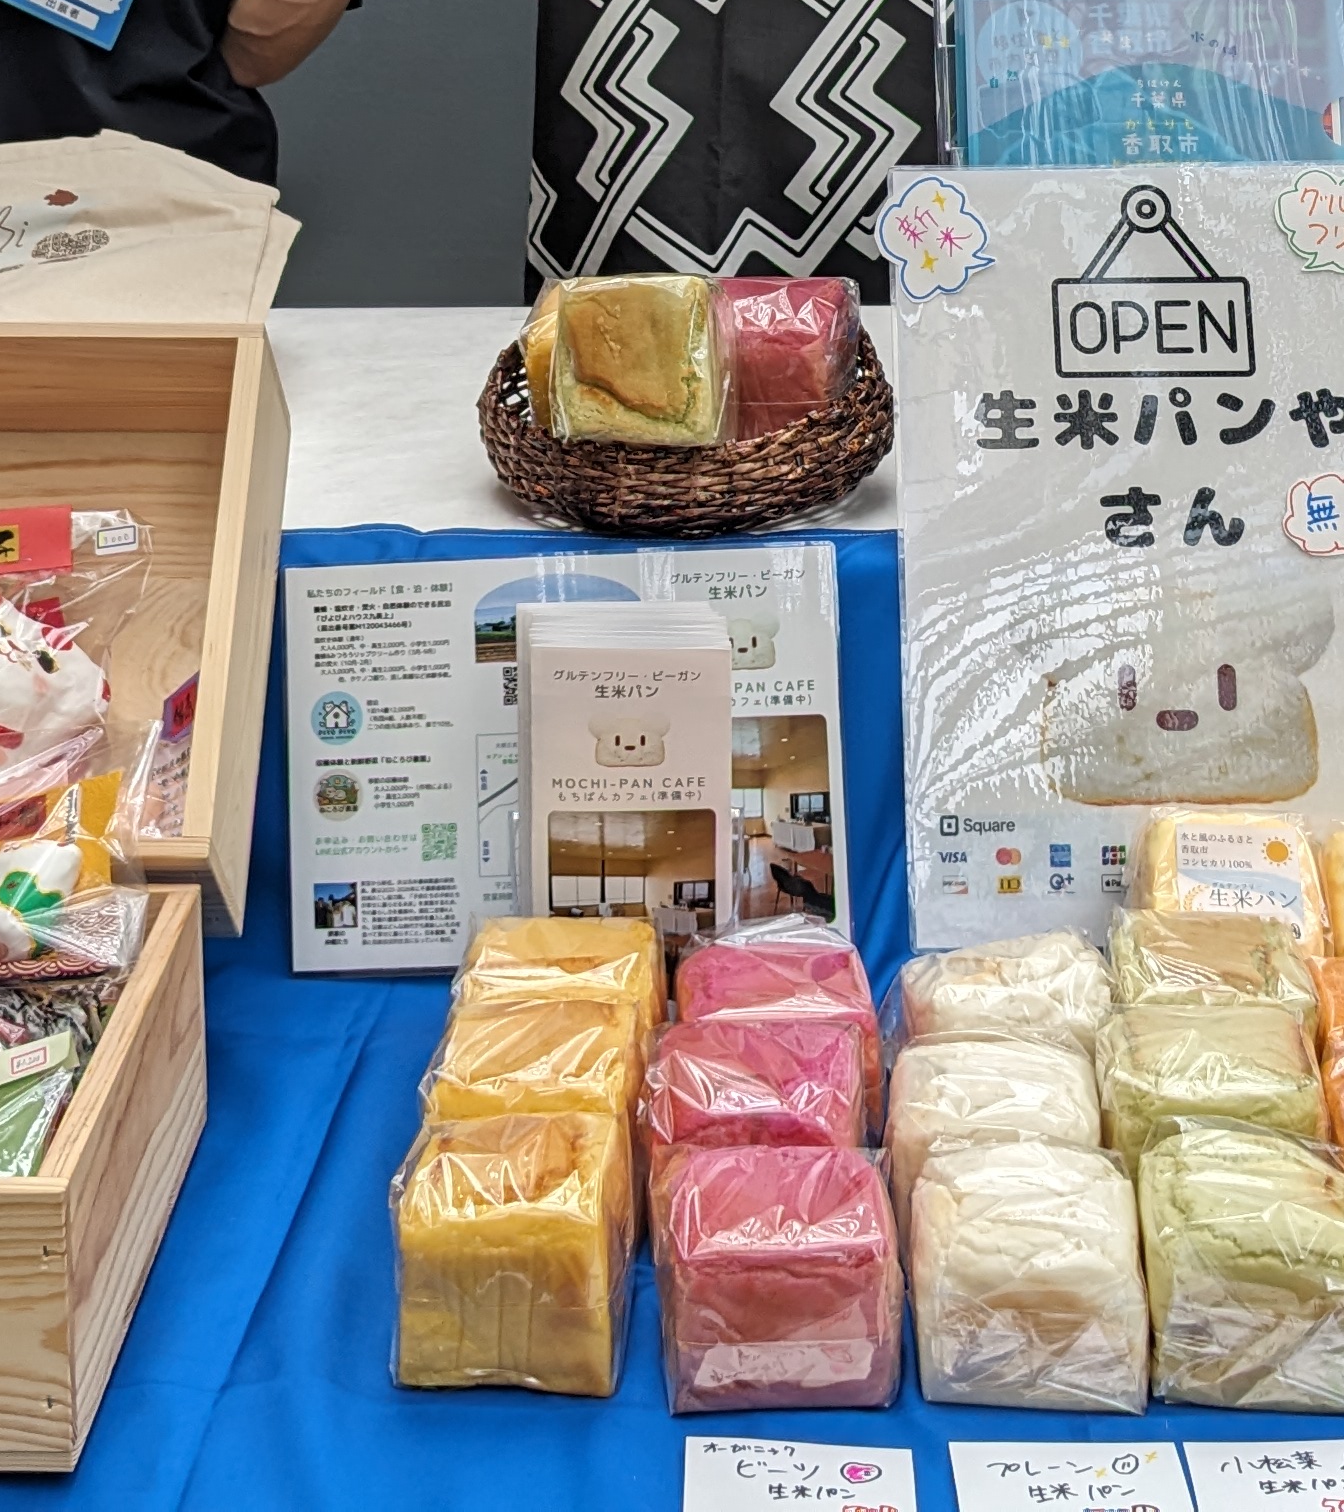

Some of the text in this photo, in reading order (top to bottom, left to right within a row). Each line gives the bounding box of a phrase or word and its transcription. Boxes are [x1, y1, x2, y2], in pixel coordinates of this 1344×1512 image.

[1130, 90, 1187, 109] 千葉県
[1121, 134, 1200, 156] 香取市
[894, 207, 975, 258] 新米
[1067, 299, 1239, 355] OPEN
[1101, 484, 1245, 548] さん
[671, 569, 806, 585] グルテンフリー・ビーガン
[708, 584, 768, 601] 生米パン
[553, 669, 702, 682] グルテンフリー・ビーガン
[594, 684, 659, 699] 生米パン
[734, 679, 816, 694] PAN CAFE
[551, 776, 706, 789] MOCHI-PAN CAFE
[963, 817, 1016, 837] Square
[1181, 832, 1254, 844] 水と風のふるさと
[937, 851, 968, 863] VISA
[1181, 844, 1209, 854] 香取市
[1181, 859, 1253, 870] コシヒカリ100%
[1208, 887, 1298, 909] 生米パン
[736, 1459, 820, 1481] ビーツ
[986, 1460, 1093, 1477] プレーン
[1220, 1451, 1323, 1473] 小松菜
[768, 1482, 856, 1501] 生米パン
[1028, 1484, 1136, 1502] 生米パン
